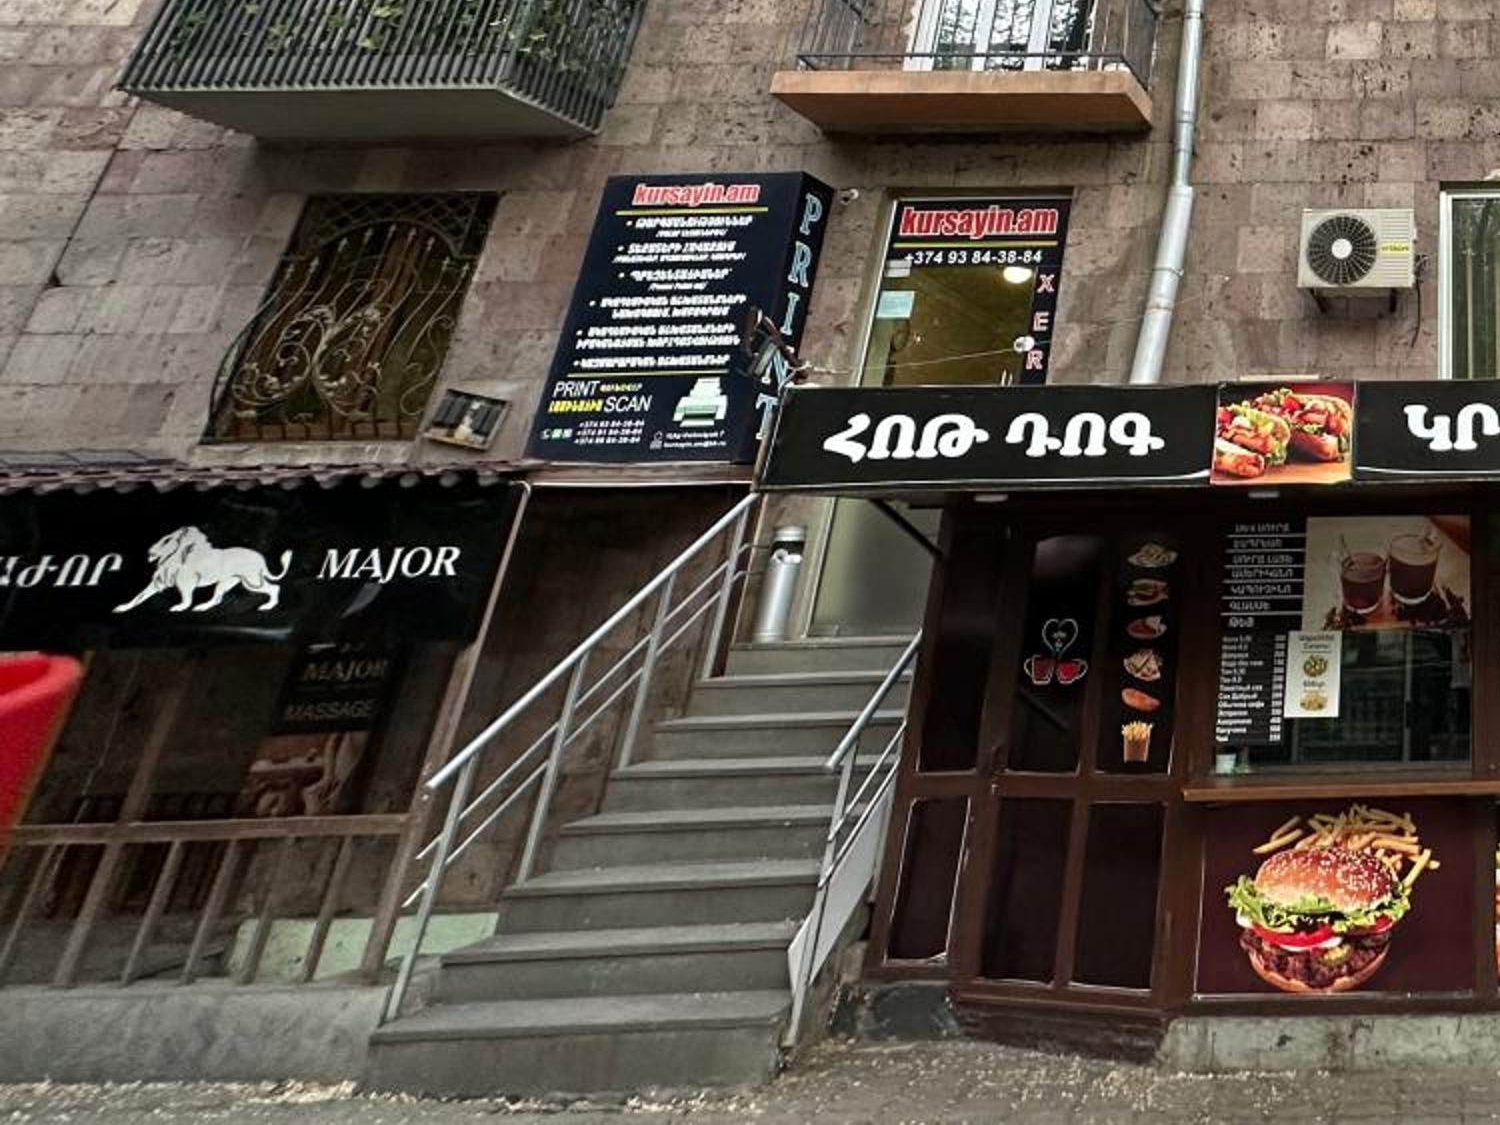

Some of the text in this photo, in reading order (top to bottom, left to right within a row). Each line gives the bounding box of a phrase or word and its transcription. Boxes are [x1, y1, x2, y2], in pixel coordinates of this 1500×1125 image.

[632, 183, 760, 207] kursayin.am
[899, 205, 1058, 240] kursayin.am
[904, 250, 1042, 266] +374 93 84-38-84
[553, 381, 600, 398] PRINT
[603, 395, 652, 412] SCAN
[822, 412, 1166, 463] ՀՈԹ ԴՈԳ
[316, 546, 461, 584] MAJOR
